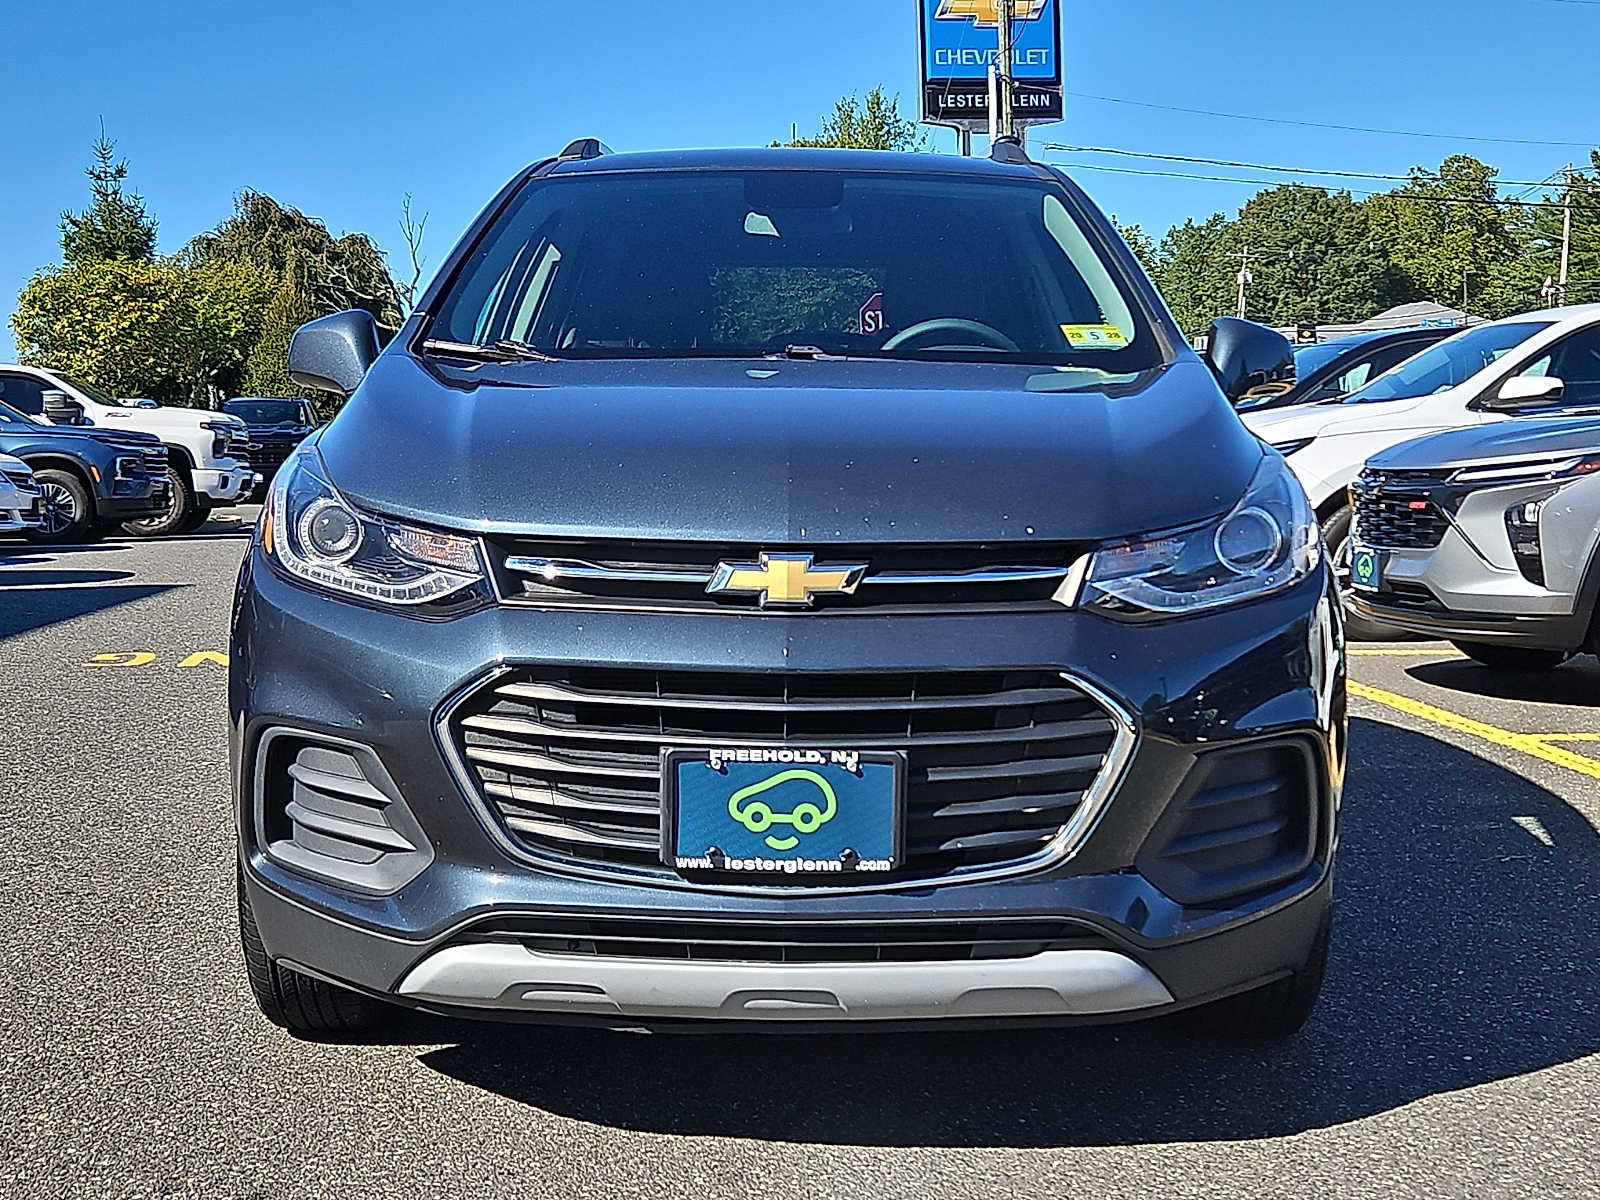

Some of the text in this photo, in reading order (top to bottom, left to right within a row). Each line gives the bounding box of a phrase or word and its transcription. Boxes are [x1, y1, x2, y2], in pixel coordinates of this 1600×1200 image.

[935, 49, 1049, 65] CHEVRLET
[1011, 94, 1050, 107] LENN
[864, 310, 882, 332] ST
[1089, 331, 1100, 340] 5
[709, 749, 859, 764] FREEHOLD, NJ
